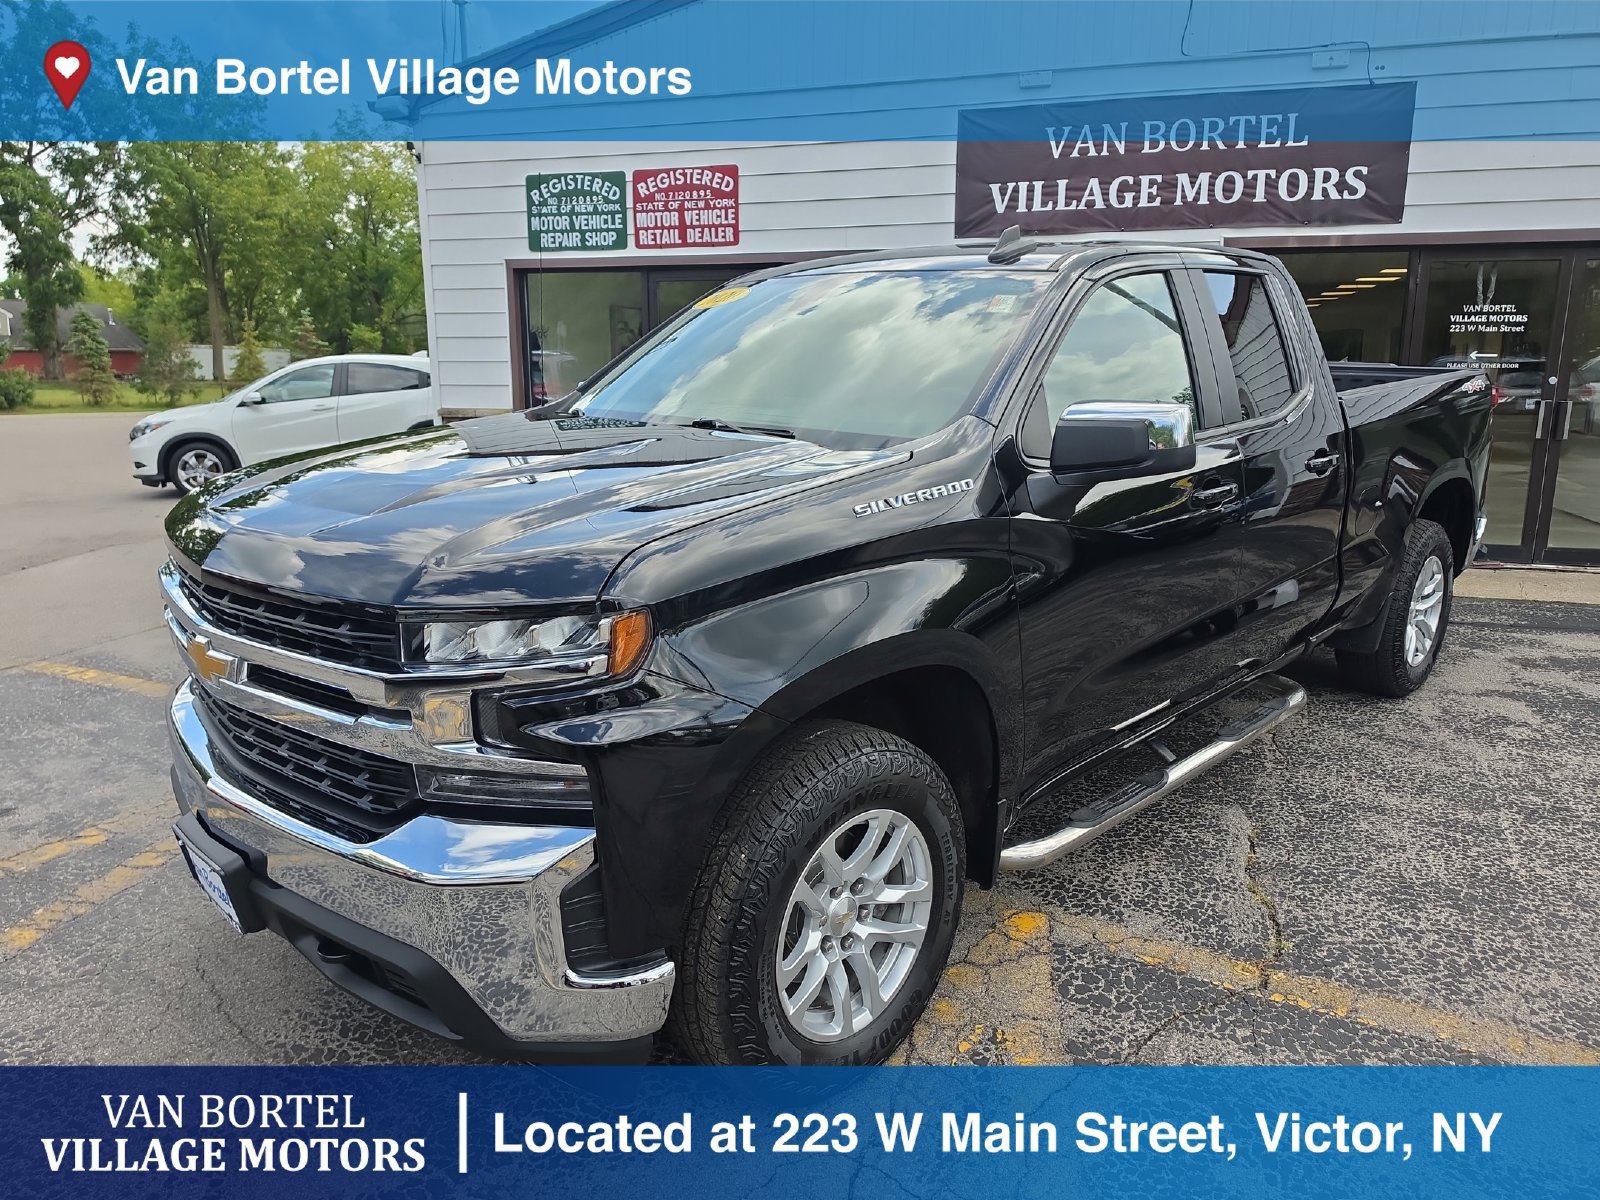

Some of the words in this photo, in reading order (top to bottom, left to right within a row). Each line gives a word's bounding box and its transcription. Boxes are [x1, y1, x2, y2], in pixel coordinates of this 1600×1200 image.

[1045, 121, 1127, 159] VAN
[1141, 112, 1309, 155] BORTEL
[530, 174, 621, 204] REGISTERED
[637, 168, 735, 197] REGISTERED
[989, 174, 1164, 214] VILLAGE
[1175, 165, 1370, 207] MOTORS
[561, 195, 604, 205] 7120895
[668, 190, 712, 200] 7120895
[531, 205, 558, 214] STATE
[560, 205, 572, 213] OF
[574, 204, 596, 212] NEW
[597, 203, 621, 212] YORK
[636, 201, 663, 211] STATE
[667, 201, 681, 209] OF
[684, 200, 705, 209] NEW
[709, 198, 736, 207] YORK
[531, 215, 570, 231] MOTOR
[573, 214, 623, 230] VEHICLE
[636, 211, 680, 228] MOTOR
[684, 208, 736, 226] VEHICLE
[540, 232, 582, 248] REPAIR
[585, 231, 617, 246] SHOP
[639, 228, 682, 245] RETAIL
[686, 227, 734, 243] DEALER
[1463, 304, 1481, 312] VAN
[1482, 304, 1517, 312] BORTEL
[1450, 314, 1488, 322] VILLAGE
[1489, 314, 1528, 322] MOTORS
[1449, 324, 1465, 332] 223
[1467, 324, 1477, 332] W
[1478, 324, 1498, 332] Main
[1499, 324, 1525, 332] Street
[852, 478, 975, 518] SILVERADO
[941, 831, 954, 901] TERRITORY
